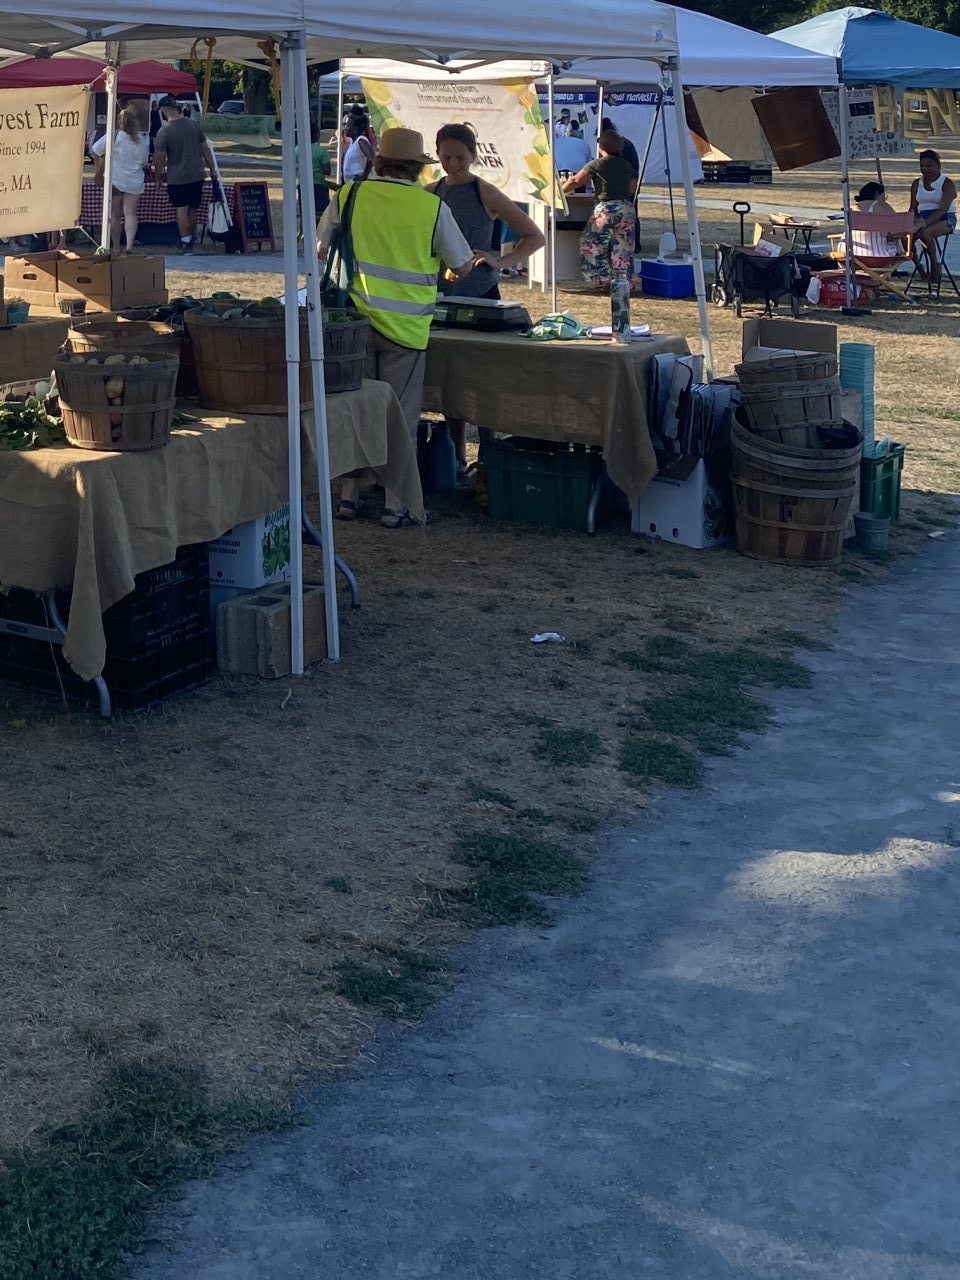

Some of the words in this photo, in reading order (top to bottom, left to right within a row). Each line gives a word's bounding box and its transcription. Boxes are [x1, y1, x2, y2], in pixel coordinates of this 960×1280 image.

[417, 93, 434, 102] from
[435, 94, 458, 103] around
[458, 95, 472, 104] the
[471, 95, 493, 104] world
[35, 103, 80, 128] Farm
[25, 140, 46, 154] 1994
[11, 173, 33, 191] MA
